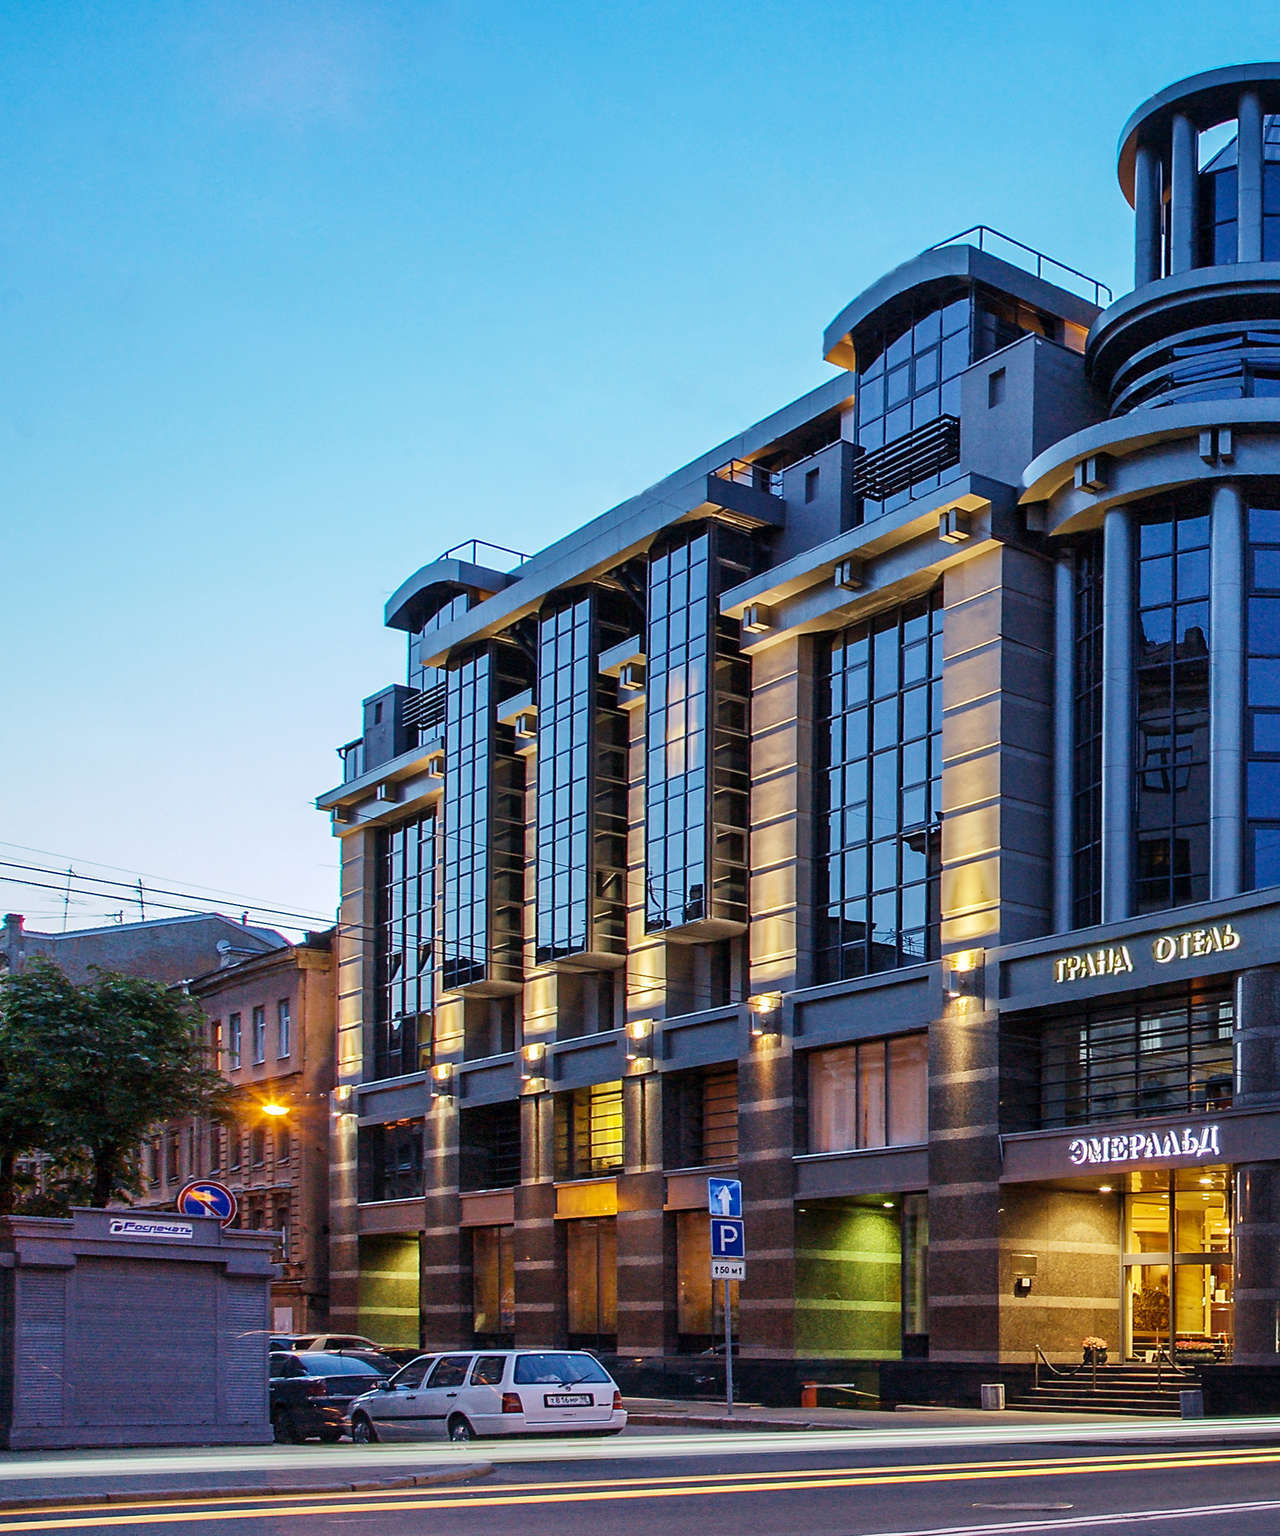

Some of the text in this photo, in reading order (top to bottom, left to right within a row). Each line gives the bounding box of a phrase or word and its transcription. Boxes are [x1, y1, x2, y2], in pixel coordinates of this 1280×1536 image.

[1054, 923, 1242, 984] ГРАНД ОТЕЛЬ
[1069, 1124, 1221, 1166] ЭМЕРАЛЬД
[123, 1221, 192, 1235] Госпечать
[720, 1225, 738, 1252] P
[720, 1266, 730, 1274] 50
